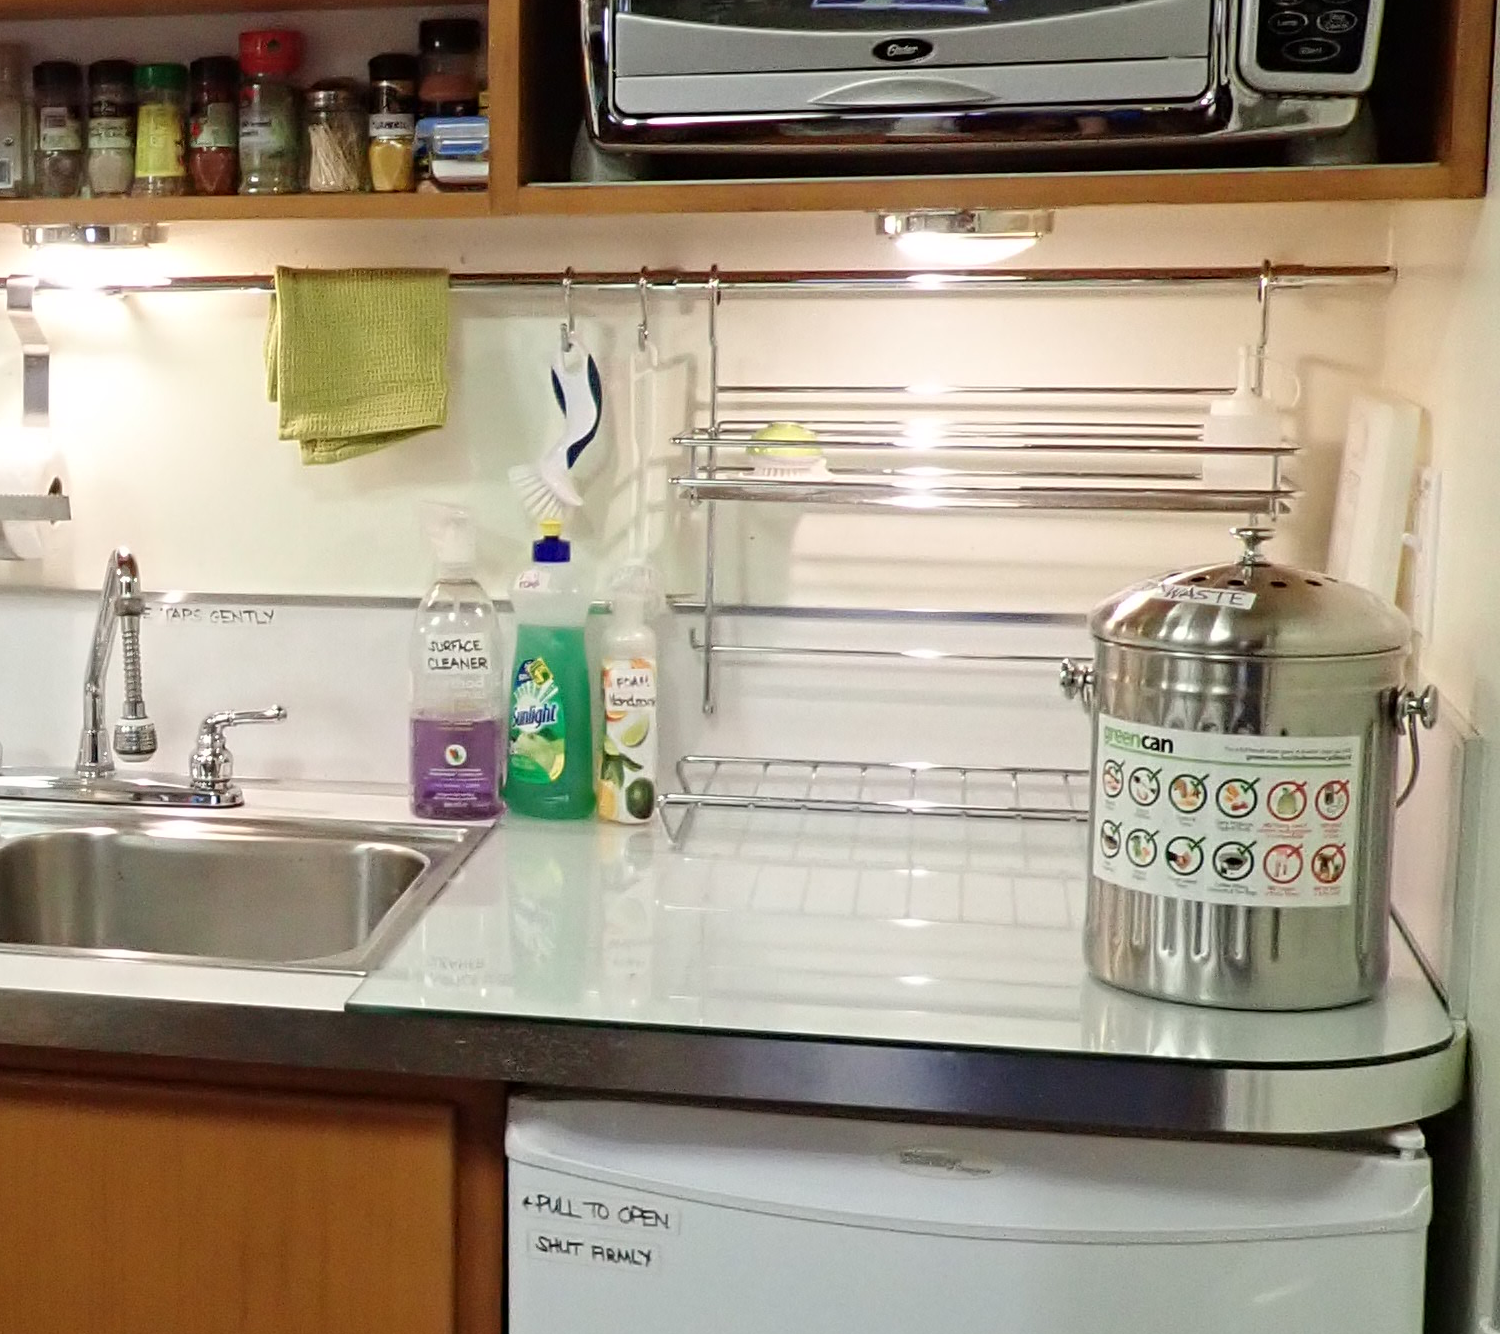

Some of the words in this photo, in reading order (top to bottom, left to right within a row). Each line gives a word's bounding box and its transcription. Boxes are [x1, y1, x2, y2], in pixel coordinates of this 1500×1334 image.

[1162, 584, 1244, 606] WASTE
[210, 609, 274, 624] GENTLY
[428, 639, 483, 652] SURFACE
[428, 657, 488, 670] CLEANER
[513, 703, 557, 728] Sunlight
[536, 1194, 582, 1219] PULL
[583, 1202, 610, 1220] TO
[618, 1205, 670, 1229] OPEN
[535, 1235, 584, 1256] SHUT
[591, 1245, 652, 1267] FIRMLY
